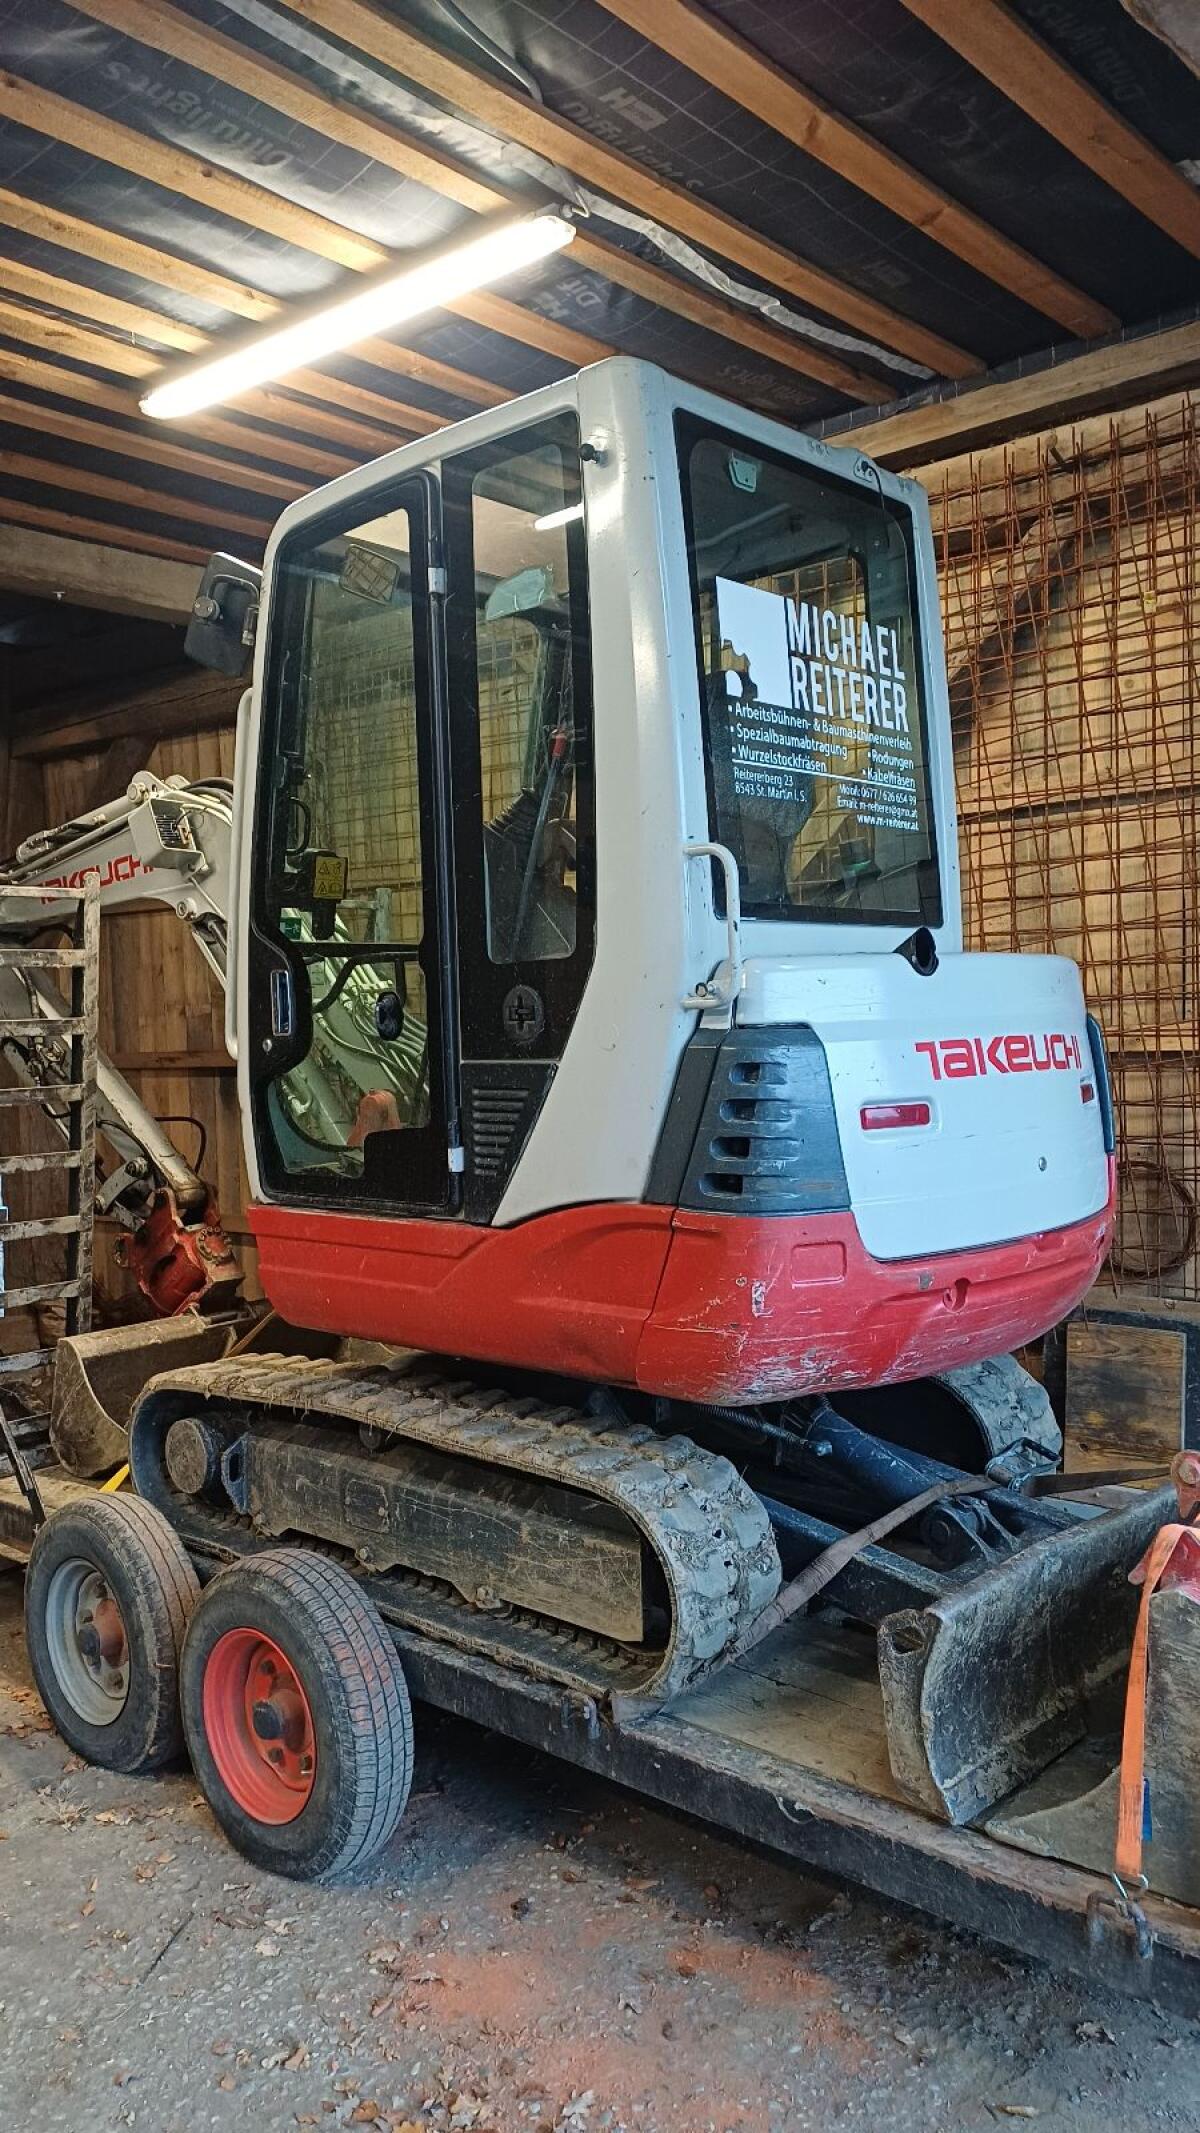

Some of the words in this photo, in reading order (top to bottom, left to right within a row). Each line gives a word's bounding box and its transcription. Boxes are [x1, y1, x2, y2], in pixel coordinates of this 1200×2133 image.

[786, 597, 906, 681] MICHAEL
[790, 655, 909, 732] REITERER
[735, 702, 812, 730] Arbeitsbühnen-
[813, 718, 821, 732] &
[822, 722, 913, 751] Baumaschinenverleih
[736, 724, 848, 759] Spezialbaumabtragung
[738, 744, 827, 772] Wurzelstockfräsen
[867, 766, 916, 788] Kabelfräsen
[871, 749, 914, 770] Rodungen
[914, 1033, 1082, 1081] TAKEUCHI
